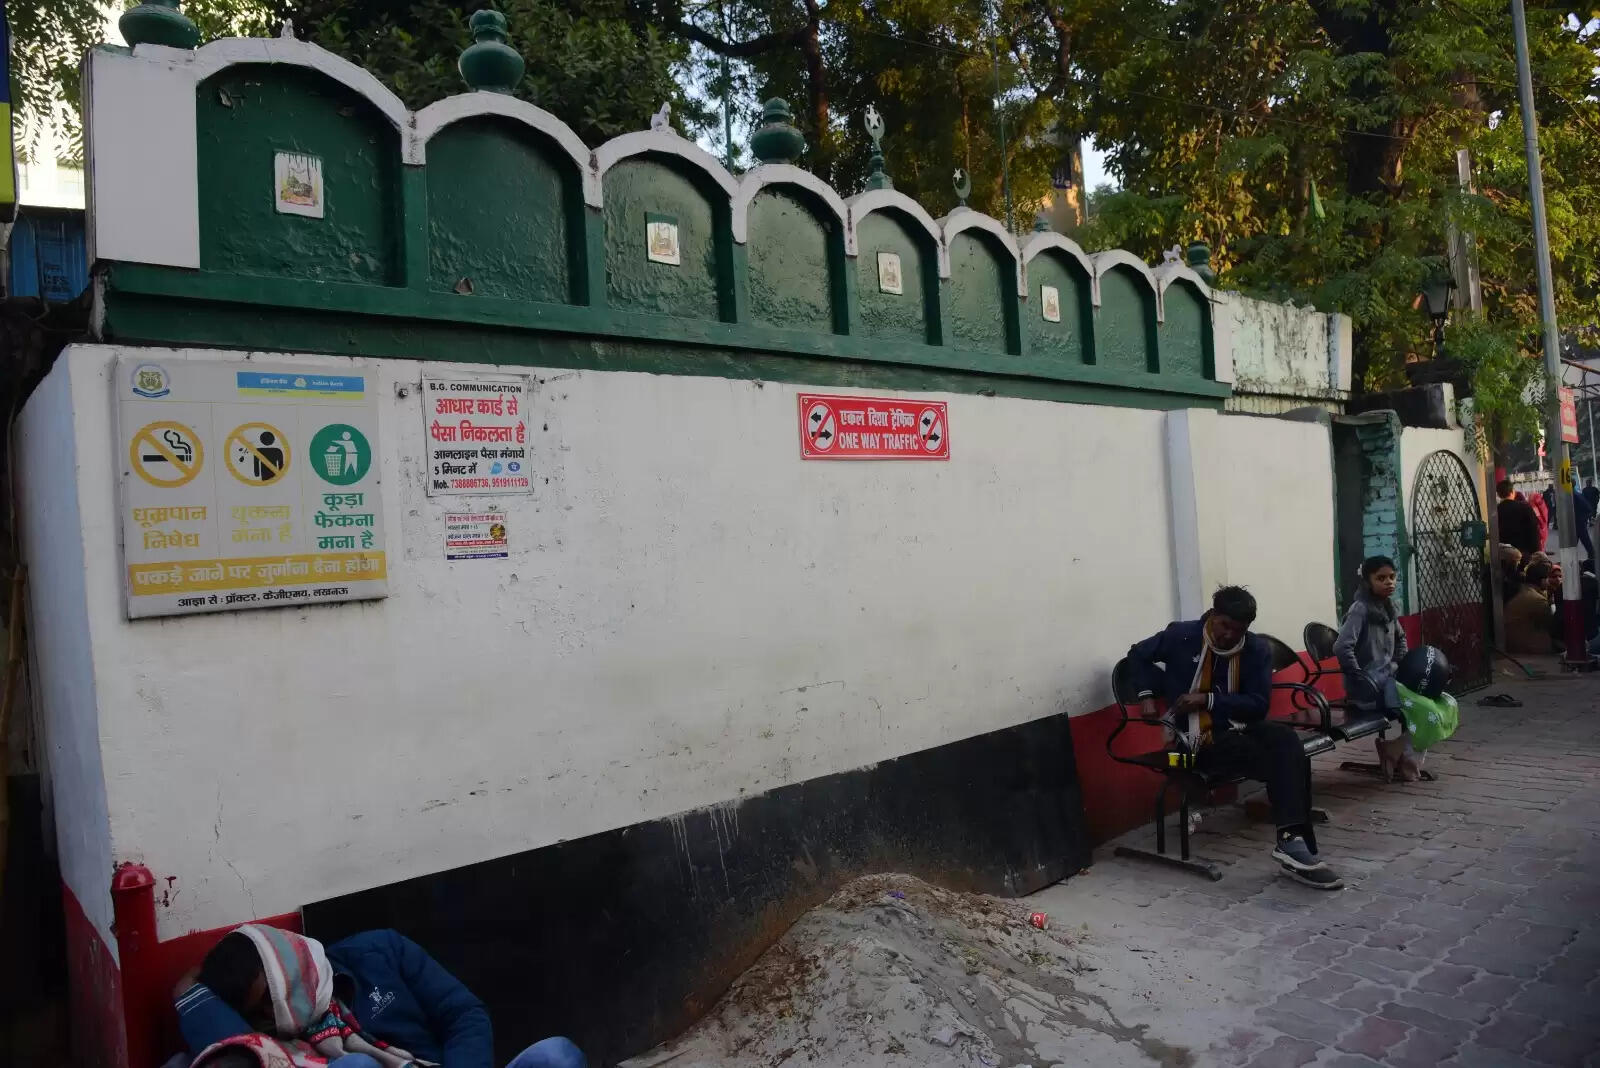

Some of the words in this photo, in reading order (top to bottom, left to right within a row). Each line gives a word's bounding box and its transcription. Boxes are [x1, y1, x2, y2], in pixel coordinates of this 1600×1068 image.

[430, 383, 447, 391] B.G.
[450, 384, 521, 393] COMMUNICATION
[436, 398, 474, 414] आधार
[506, 395, 518, 415] से
[839, 410, 865, 426] एकल
[868, 407, 889, 427] दिशा
[430, 419, 456, 441] पैसा
[459, 419, 512, 442] निकलता
[514, 420, 525, 443] है
[839, 432, 860, 449] ONE
[861, 432, 881, 449] WAY
[883, 433, 919, 450] TRAFFIC
[480, 447, 497, 459] पैसा
[500, 447, 525, 459] मंगाये
[434, 466, 440, 475] 5
[442, 462, 466, 475] मिनट
[468, 462, 478, 474] में
[433, 480, 449, 490] Mob.
[322, 492, 364, 512] कूड़ा
[314, 511, 375, 530] फेकना
[144, 530, 200, 550] निषेध
[279, 521, 293, 543] है
[318, 535, 356, 550] मना
[360, 530, 374, 550] है
[188, 562, 224, 583] जाने
[228, 565, 250, 580] पर
[313, 558, 341, 577] देना
[178, 597, 205, 608] आज्ञा
[208, 595, 219, 605] से
[313, 586, 349, 597] लखनऊ
